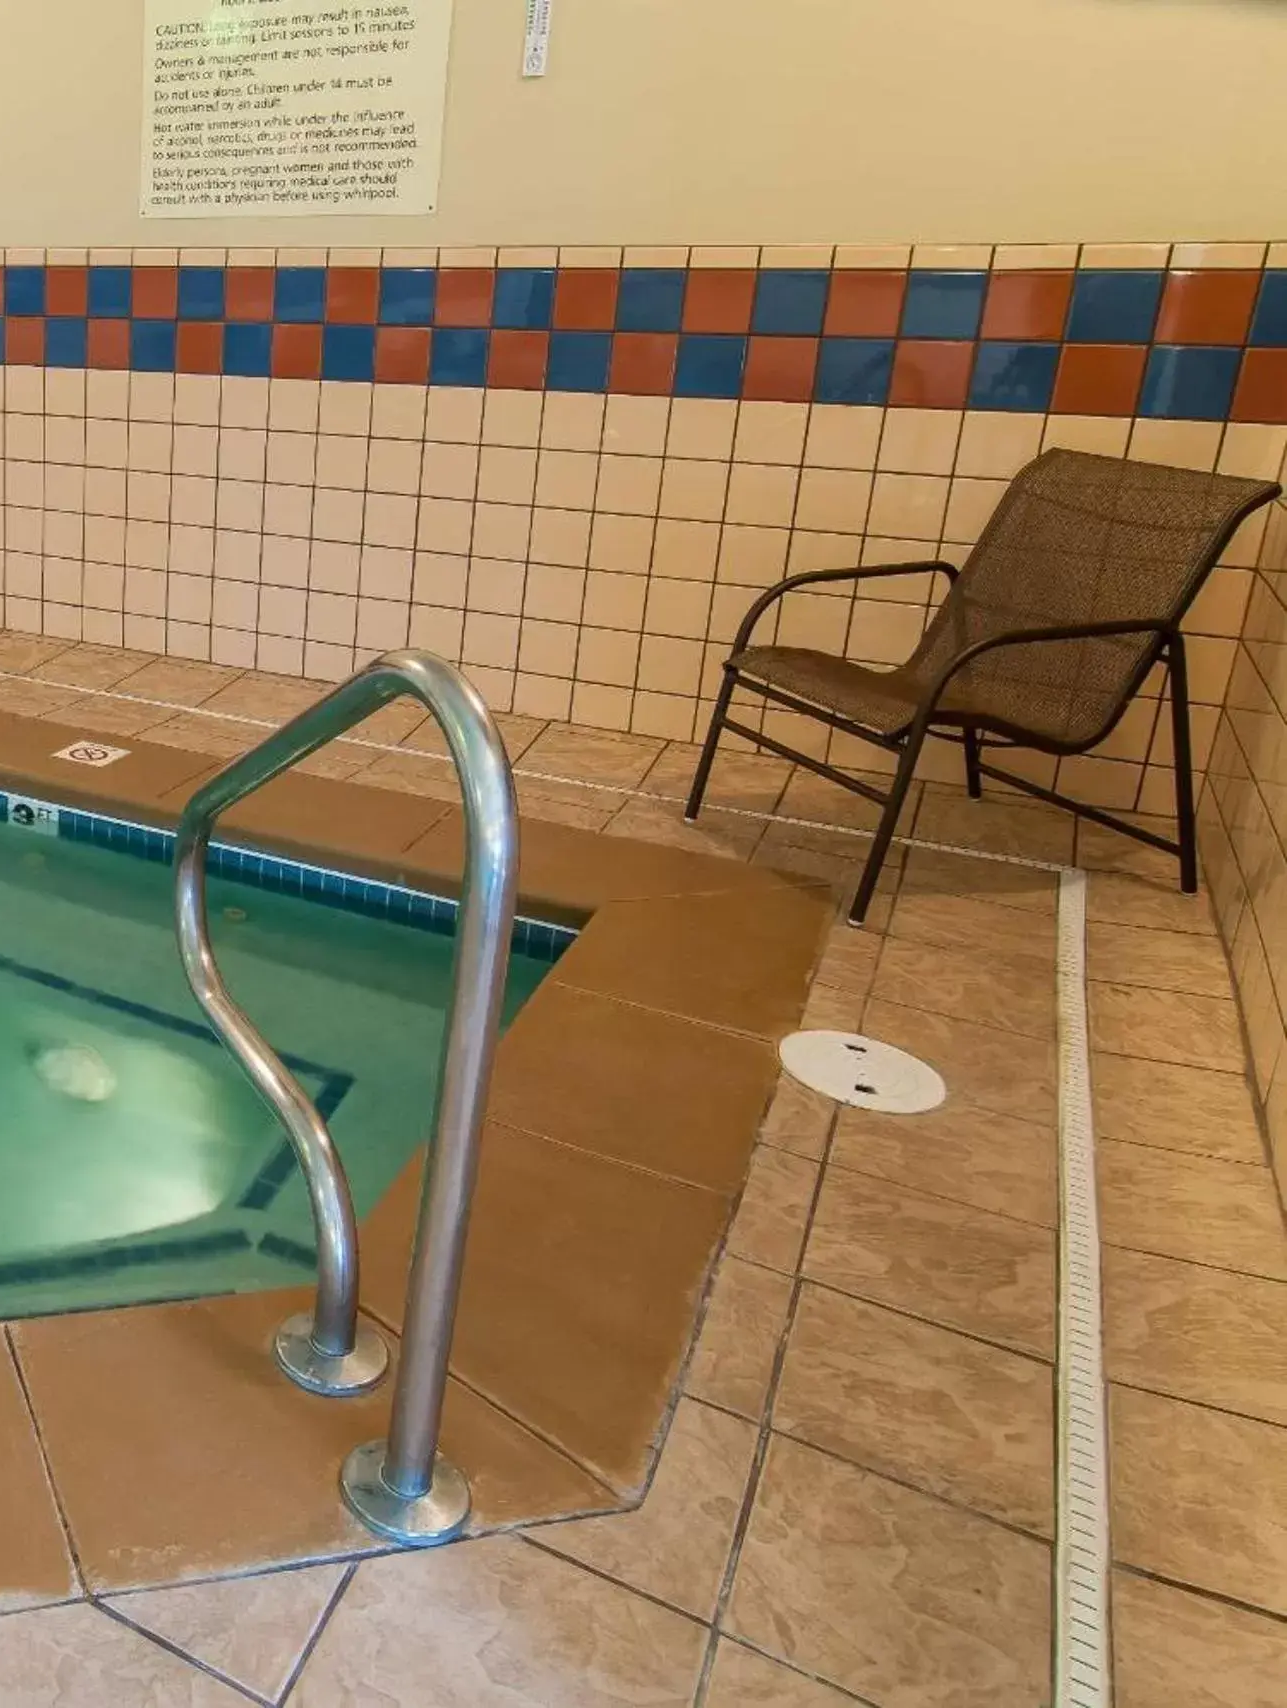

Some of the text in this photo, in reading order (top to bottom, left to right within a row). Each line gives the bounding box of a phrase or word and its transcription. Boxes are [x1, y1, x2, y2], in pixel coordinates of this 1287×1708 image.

[292, 13, 314, 26] may
[318, 8, 348, 22] result
[352, 8, 362, 18] in
[201, 38, 212, 47] or
[261, 30, 286, 42] Limit
[337, 25, 349, 36] to
[154, 38, 410, 69] Owners & management are not responsible for
[154, 71, 200, 83] accidents
[202, 70, 213, 80] or
[154, 91, 168, 102] Do
[172, 89, 189, 100] not
[192, 89, 209, 100] use
[247, 84, 290, 96] Children
[294, 80, 326, 92] under
[346, 77, 374, 88] must
[377, 76, 392, 86] be
[154, 102, 218, 114] accompanied
[222, 101, 234, 113] by
[238, 99, 251, 110] an
[154, 110, 405, 132] Hot water immersion while under the influence
[154, 136, 164, 146] of
[290, 130, 300, 140] or
[305, 126, 359, 139] medicines
[362, 126, 386, 137] may
[390, 123, 414, 134] lead
[154, 150, 164, 160] to
[166, 150, 200, 160] serious
[202, 146, 274, 159] consequences
[278, 144, 296, 154] and
[300, 144, 308, 154] is
[312, 143, 330, 154] not
[232, 164, 280, 177] pregnant
[283, 162, 324, 173] women
[328, 160, 349, 171] and
[352, 159, 384, 170] those
[388, 157, 414, 169] with
[153, 172, 398, 192] health conditions requiring medical care should
[188, 193, 213, 204] with
[214, 194, 221, 204] a
[224, 192, 269, 206] physician
[272, 190, 308, 202] before
[312, 190, 340, 202] using
[344, 187, 399, 200] whirlpool.
